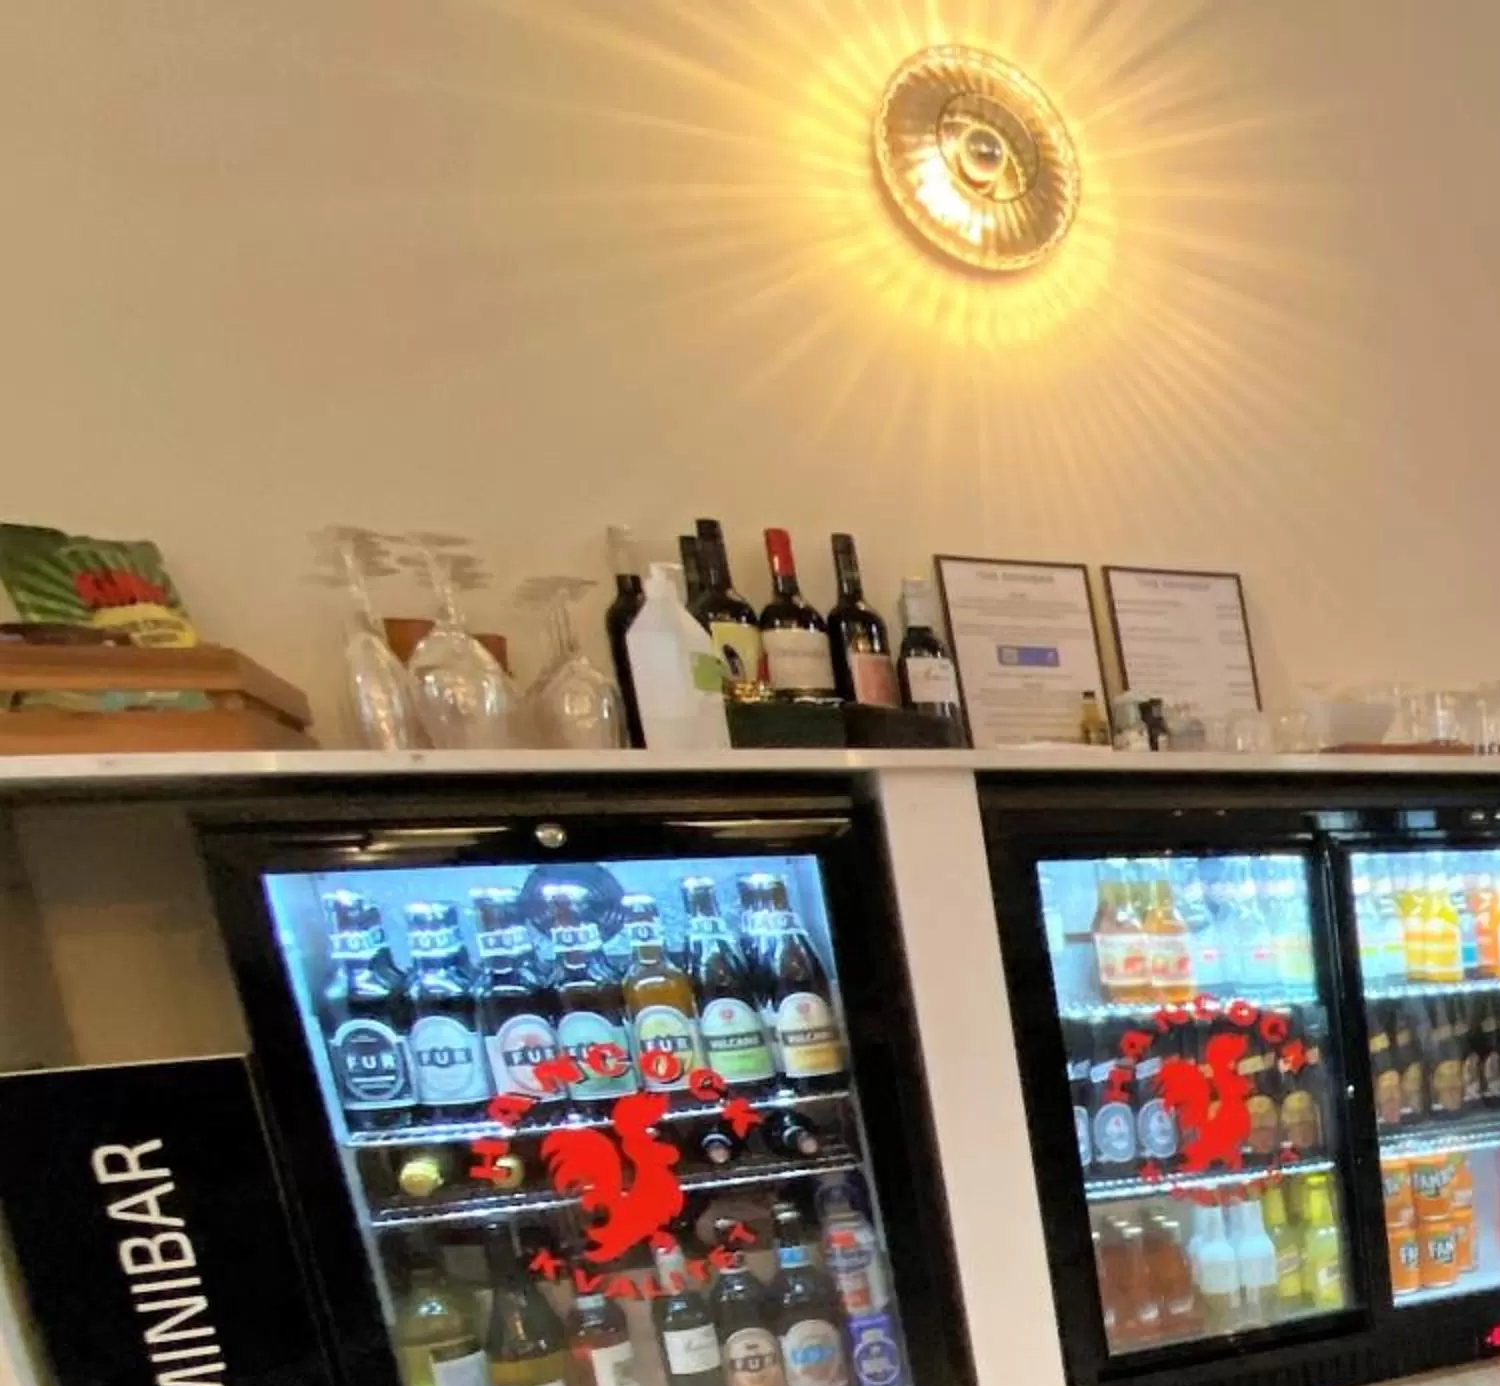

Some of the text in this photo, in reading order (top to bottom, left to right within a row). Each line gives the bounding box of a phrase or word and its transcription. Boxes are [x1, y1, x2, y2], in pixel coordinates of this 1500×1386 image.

[643, 1036, 689, 1054] FUR
[345, 1051, 397, 1070] FUR
[418, 1049, 469, 1066] FUR
